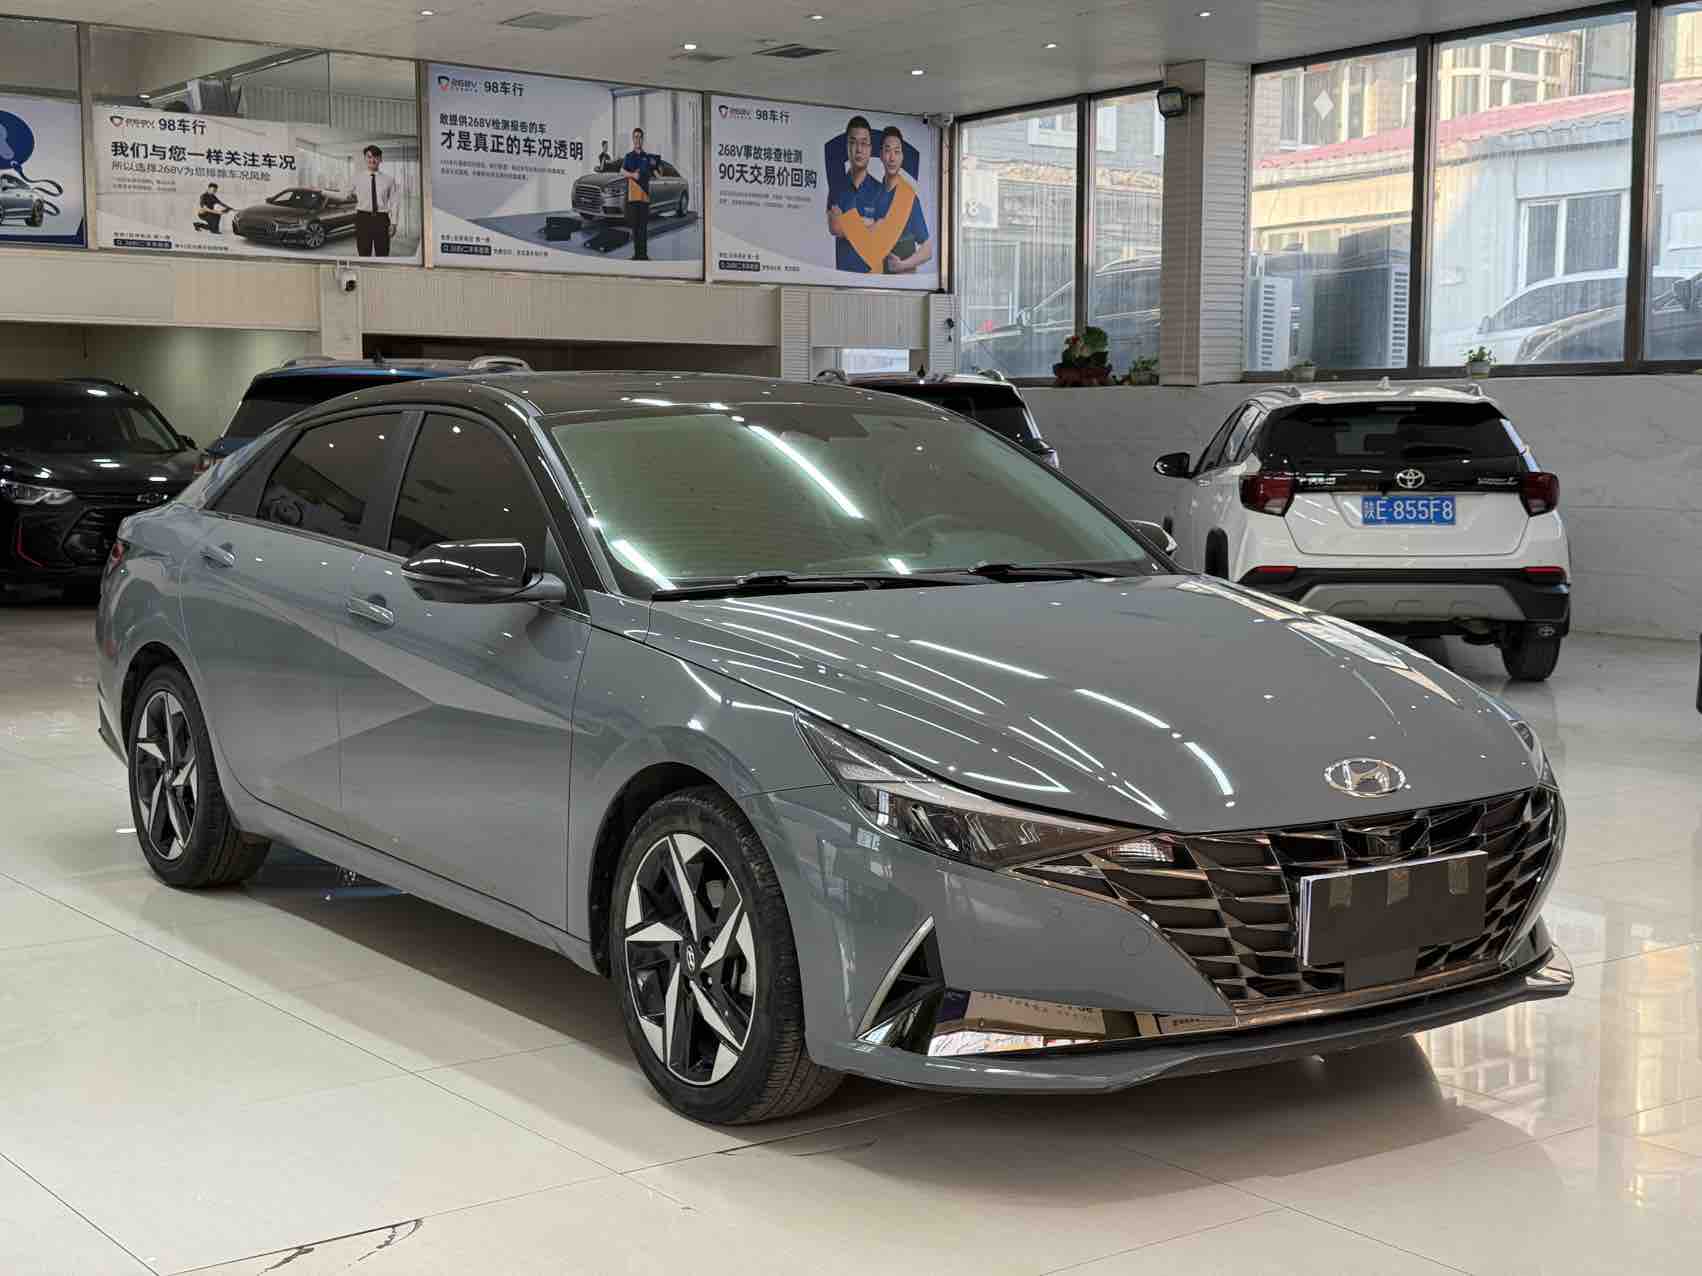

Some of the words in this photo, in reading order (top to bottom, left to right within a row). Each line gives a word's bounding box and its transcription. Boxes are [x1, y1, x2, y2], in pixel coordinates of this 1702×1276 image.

[484, 81, 525, 97] 98车行
[159, 118, 207, 135] 98车行
[440, 113, 547, 135] 敢提供268V检测报告的车
[755, 109, 791, 125] 98车行
[112, 141, 297, 171] 我们与您一样关注车况
[440, 130, 584, 161] 才是真正的车况透明
[718, 144, 803, 164] 268V事故排查检测
[719, 163, 818, 188] 90天交易价回购
